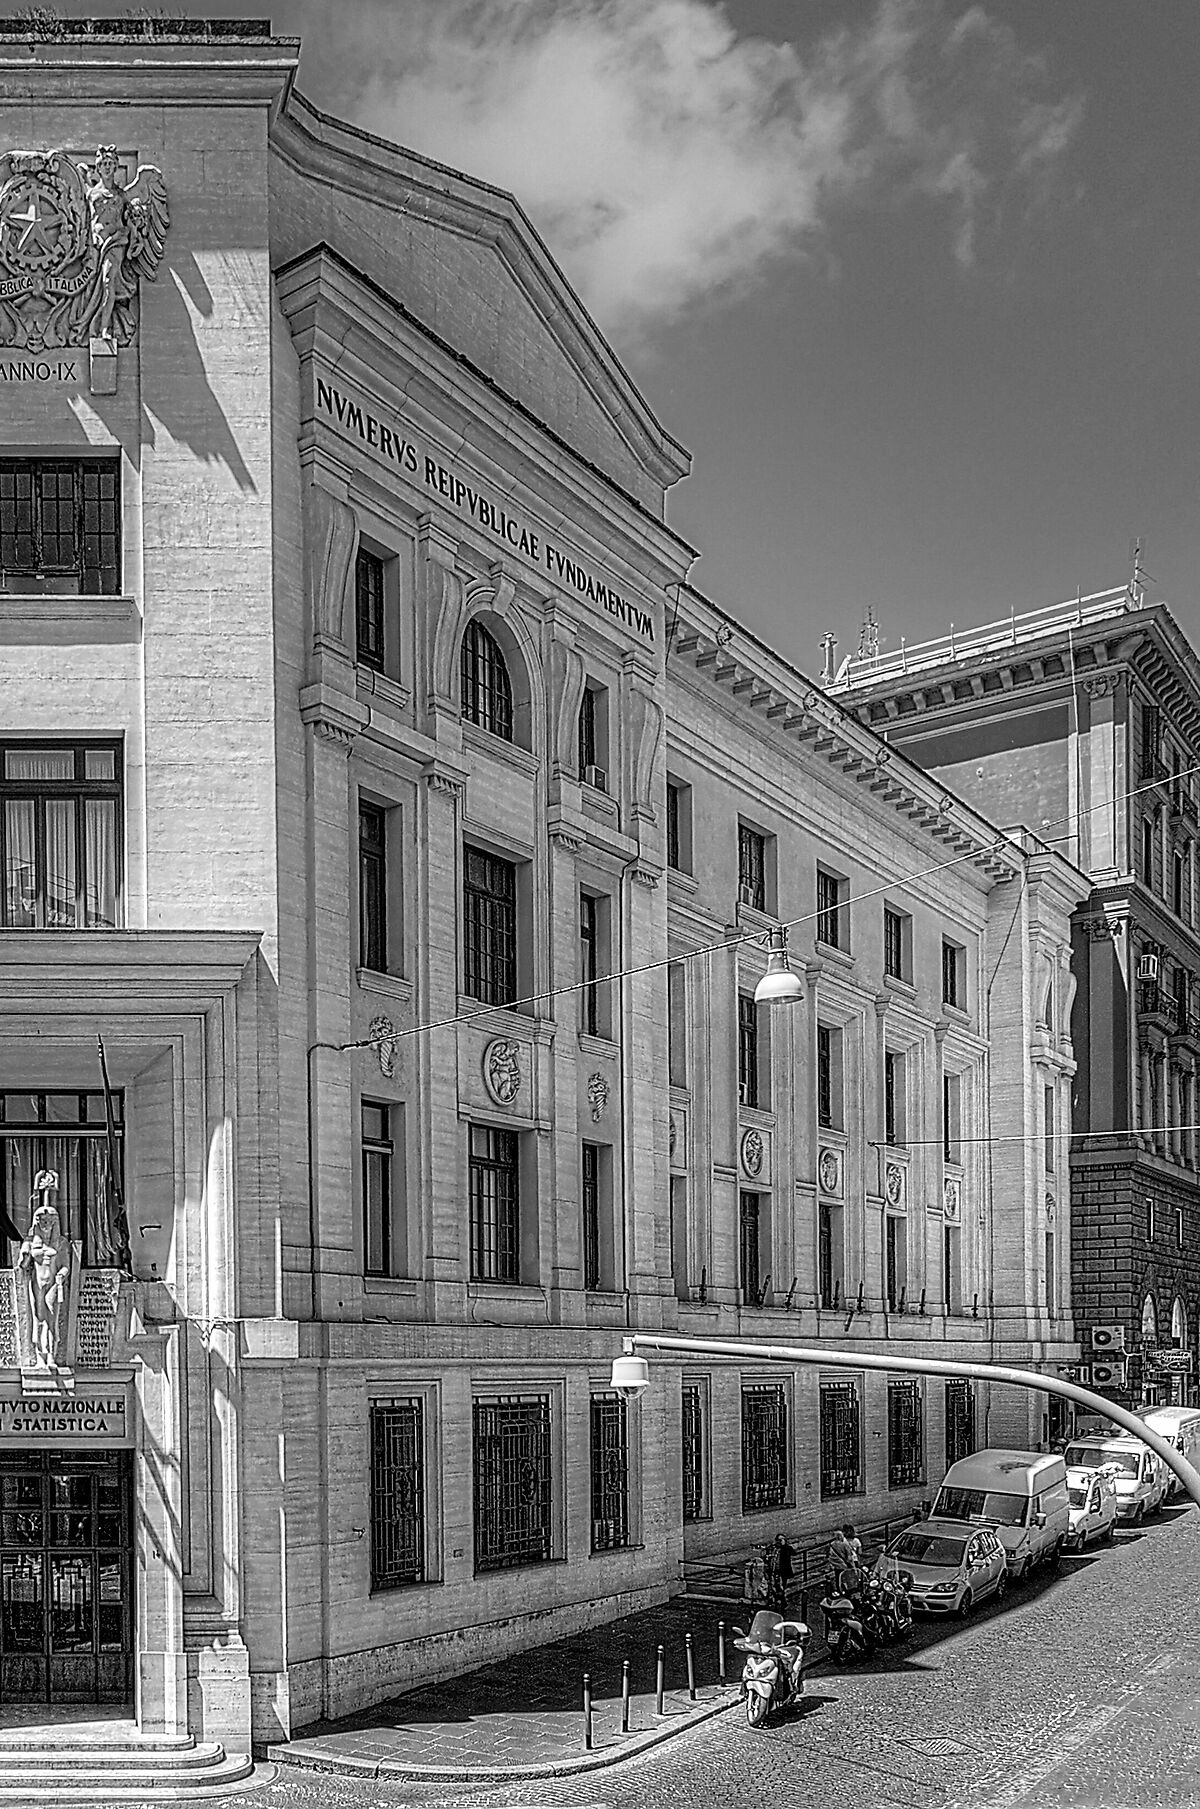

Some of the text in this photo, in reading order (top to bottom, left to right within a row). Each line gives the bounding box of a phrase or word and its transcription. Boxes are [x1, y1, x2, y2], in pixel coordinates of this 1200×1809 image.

[49, 266, 94, 293] ITALIANA
[316, 377, 655, 642] NVMERVS REIPVBLICAE FVNDAMENTVM
[42, 1400, 125, 1414] NAZIONALE
[11, 1418, 108, 1431] STATISTICA
